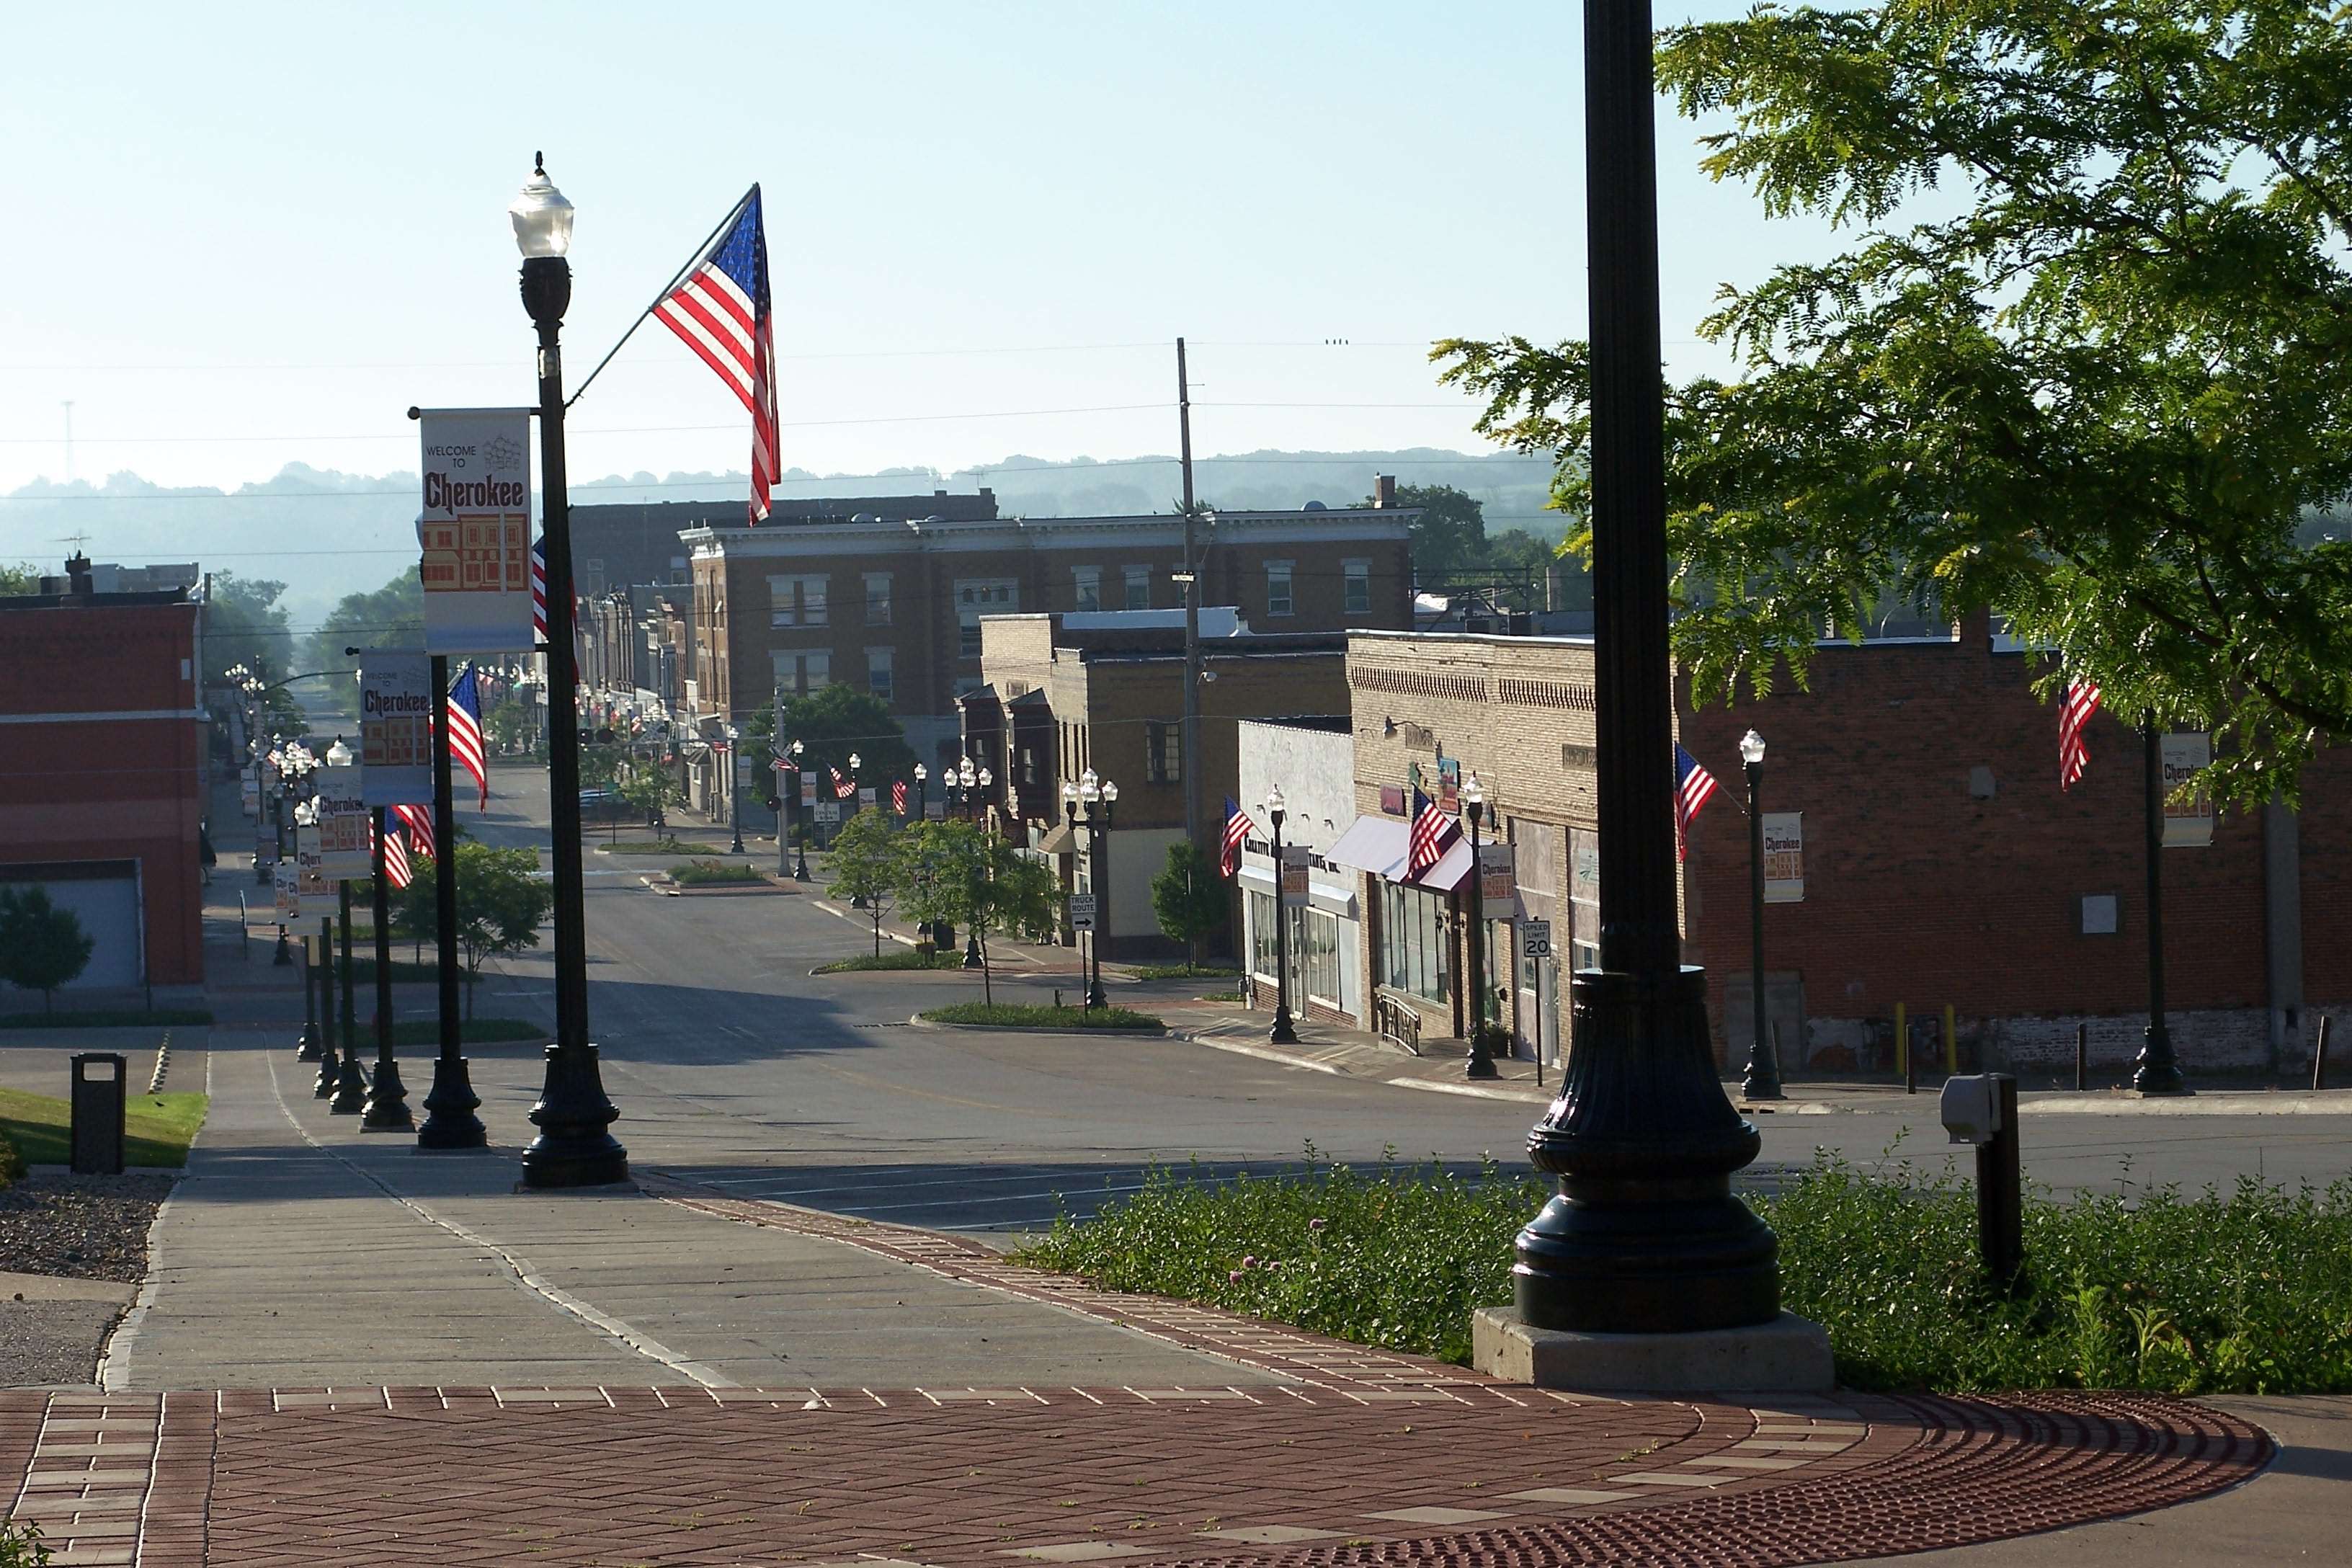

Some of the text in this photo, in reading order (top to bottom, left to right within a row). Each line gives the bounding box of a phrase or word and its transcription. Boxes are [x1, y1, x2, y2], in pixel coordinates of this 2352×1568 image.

[426, 445, 476, 457] WELCOME
[453, 458, 466, 468] TO
[425, 471, 524, 516] Cherokee
[365, 672, 398, 681] WELCOME
[364, 689, 428, 717] Cherokee
[1765, 837, 1800, 852] Cherokee
[1482, 863, 1511, 876] Cherokee
[1525, 940, 1548, 954] 20
